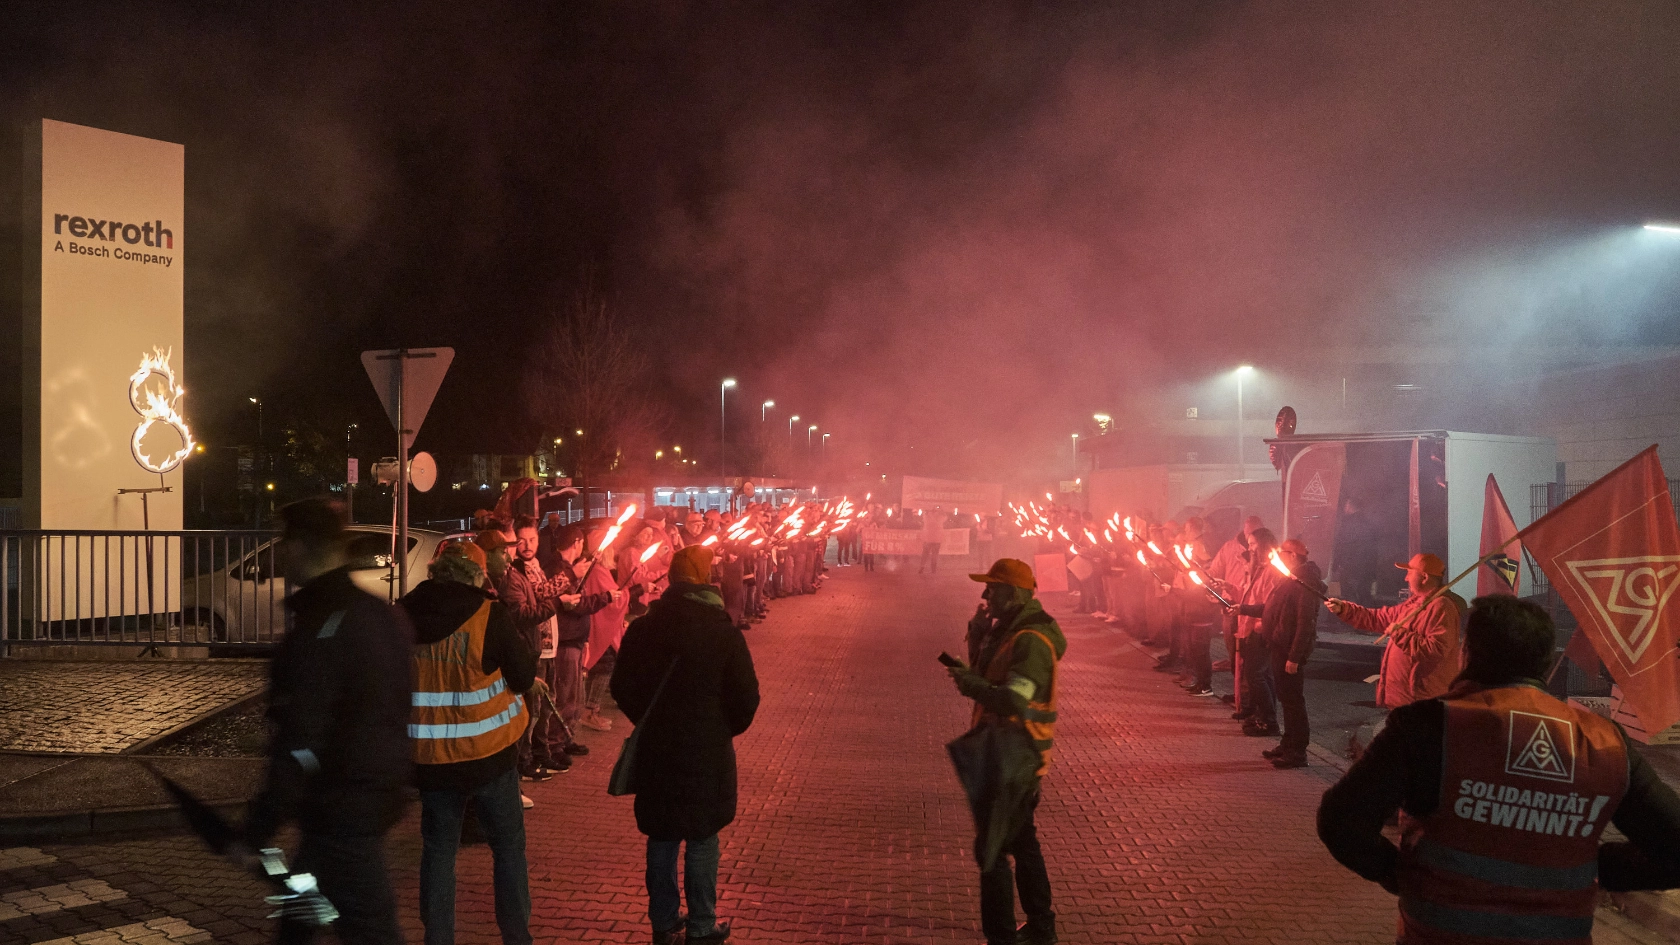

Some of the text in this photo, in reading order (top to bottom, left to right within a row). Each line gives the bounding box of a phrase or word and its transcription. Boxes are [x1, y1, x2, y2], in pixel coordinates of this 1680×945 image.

[54, 213, 173, 249] rexroth
[54, 240, 173, 267] A Bosch Company
[1459, 779, 1589, 814] SOLIDARITÄT
